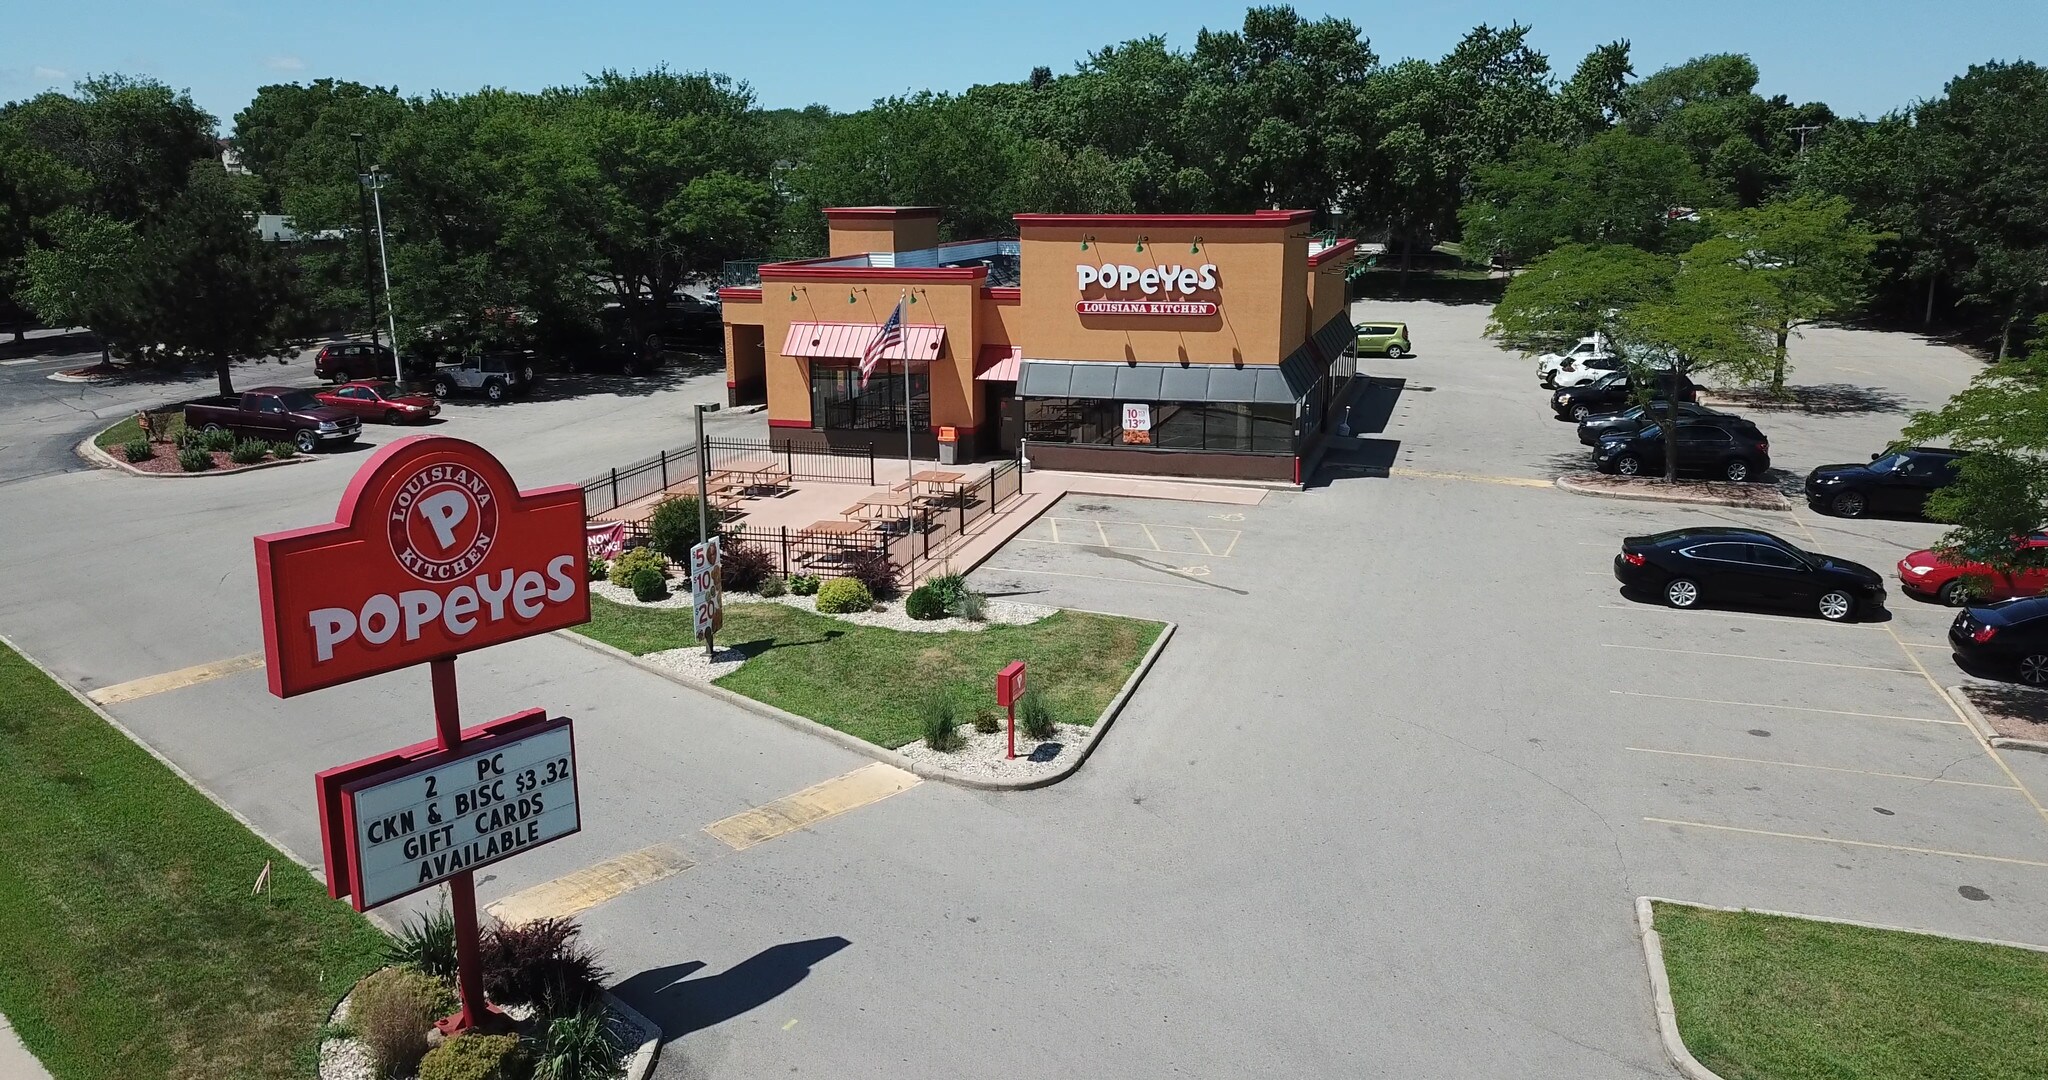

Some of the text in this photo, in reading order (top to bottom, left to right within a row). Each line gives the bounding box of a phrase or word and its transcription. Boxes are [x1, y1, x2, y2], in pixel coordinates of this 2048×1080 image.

[1084, 303, 1207, 314] LOUISIANA KITCHEN
[1127, 409, 1138, 419] 10
[392, 466, 491, 523] LOUISIANA
[417, 490, 469, 550] P
[400, 532, 492, 579] KITCHEN
[692, 547, 705, 568] $5
[693, 570, 711, 592] $10
[695, 600, 715, 624] $20
[425, 753, 505, 798] 2 PC
[367, 758, 569, 844] CKN & BISC $3.32
[403, 793, 544, 859] GIFT CARDS
[418, 820, 539, 883] AVAILABLE
